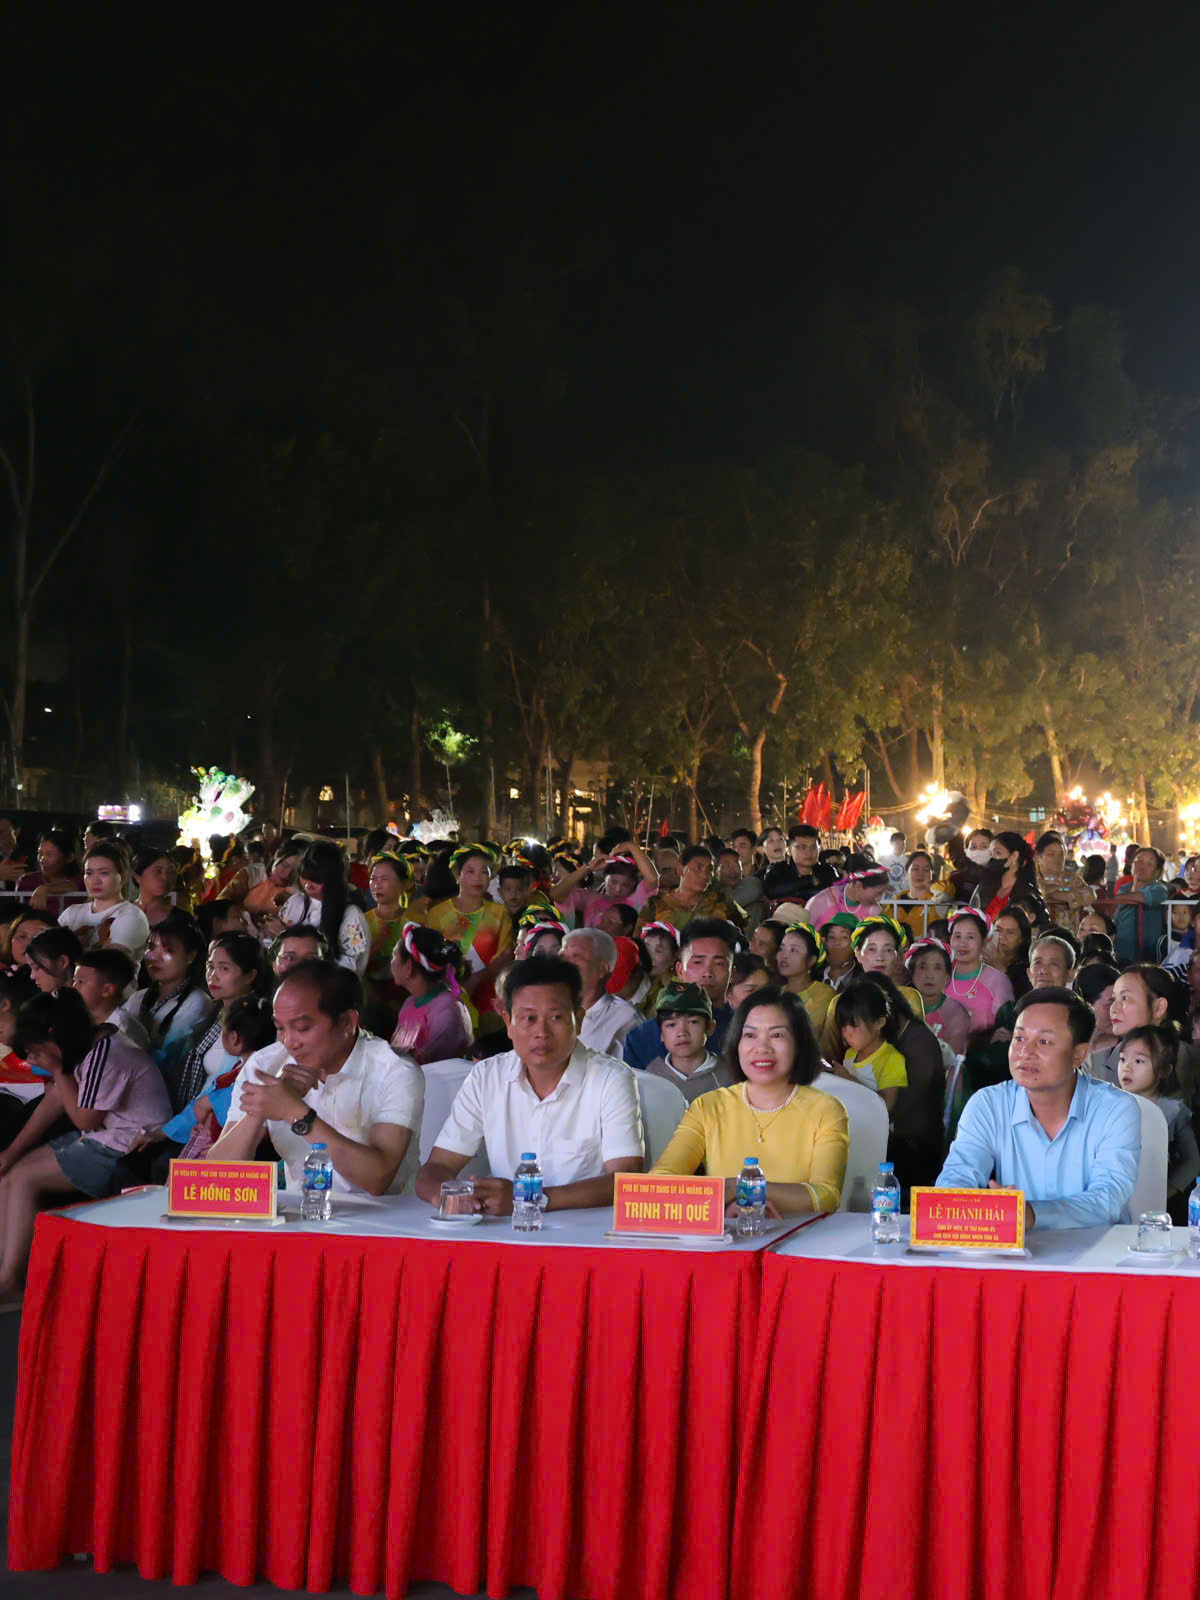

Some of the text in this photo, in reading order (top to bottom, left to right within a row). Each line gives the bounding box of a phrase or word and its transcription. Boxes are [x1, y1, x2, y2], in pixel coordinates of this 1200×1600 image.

[184, 1183, 259, 1202] LÊ HỒNG SƠN
[624, 1200, 711, 1224] TRỊNH THỊ QUẾ
[929, 1203, 944, 1219] LÊ
[945, 1207, 982, 1220] THANH
